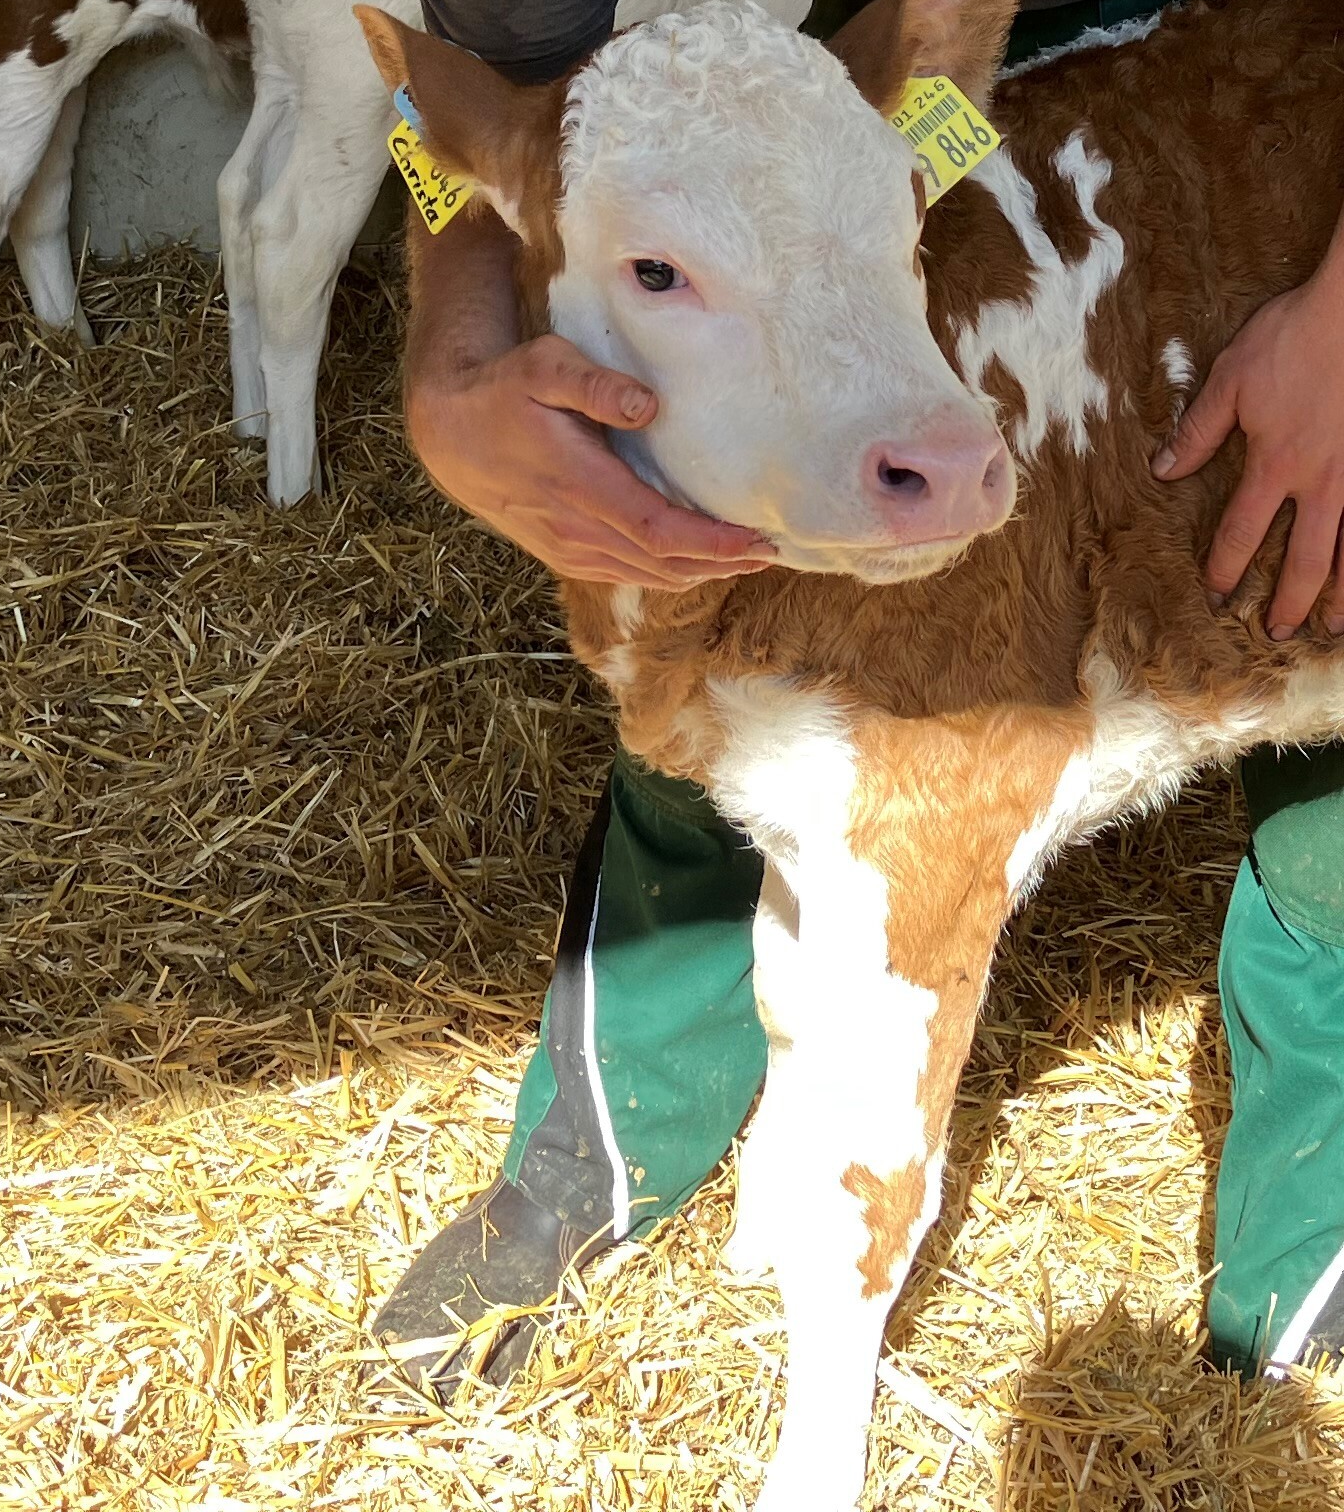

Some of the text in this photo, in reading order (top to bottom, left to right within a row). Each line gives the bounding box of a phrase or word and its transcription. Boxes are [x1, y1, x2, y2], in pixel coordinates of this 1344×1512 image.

[891, 78, 945, 129] 01 246
[936, 111, 992, 168] 846
